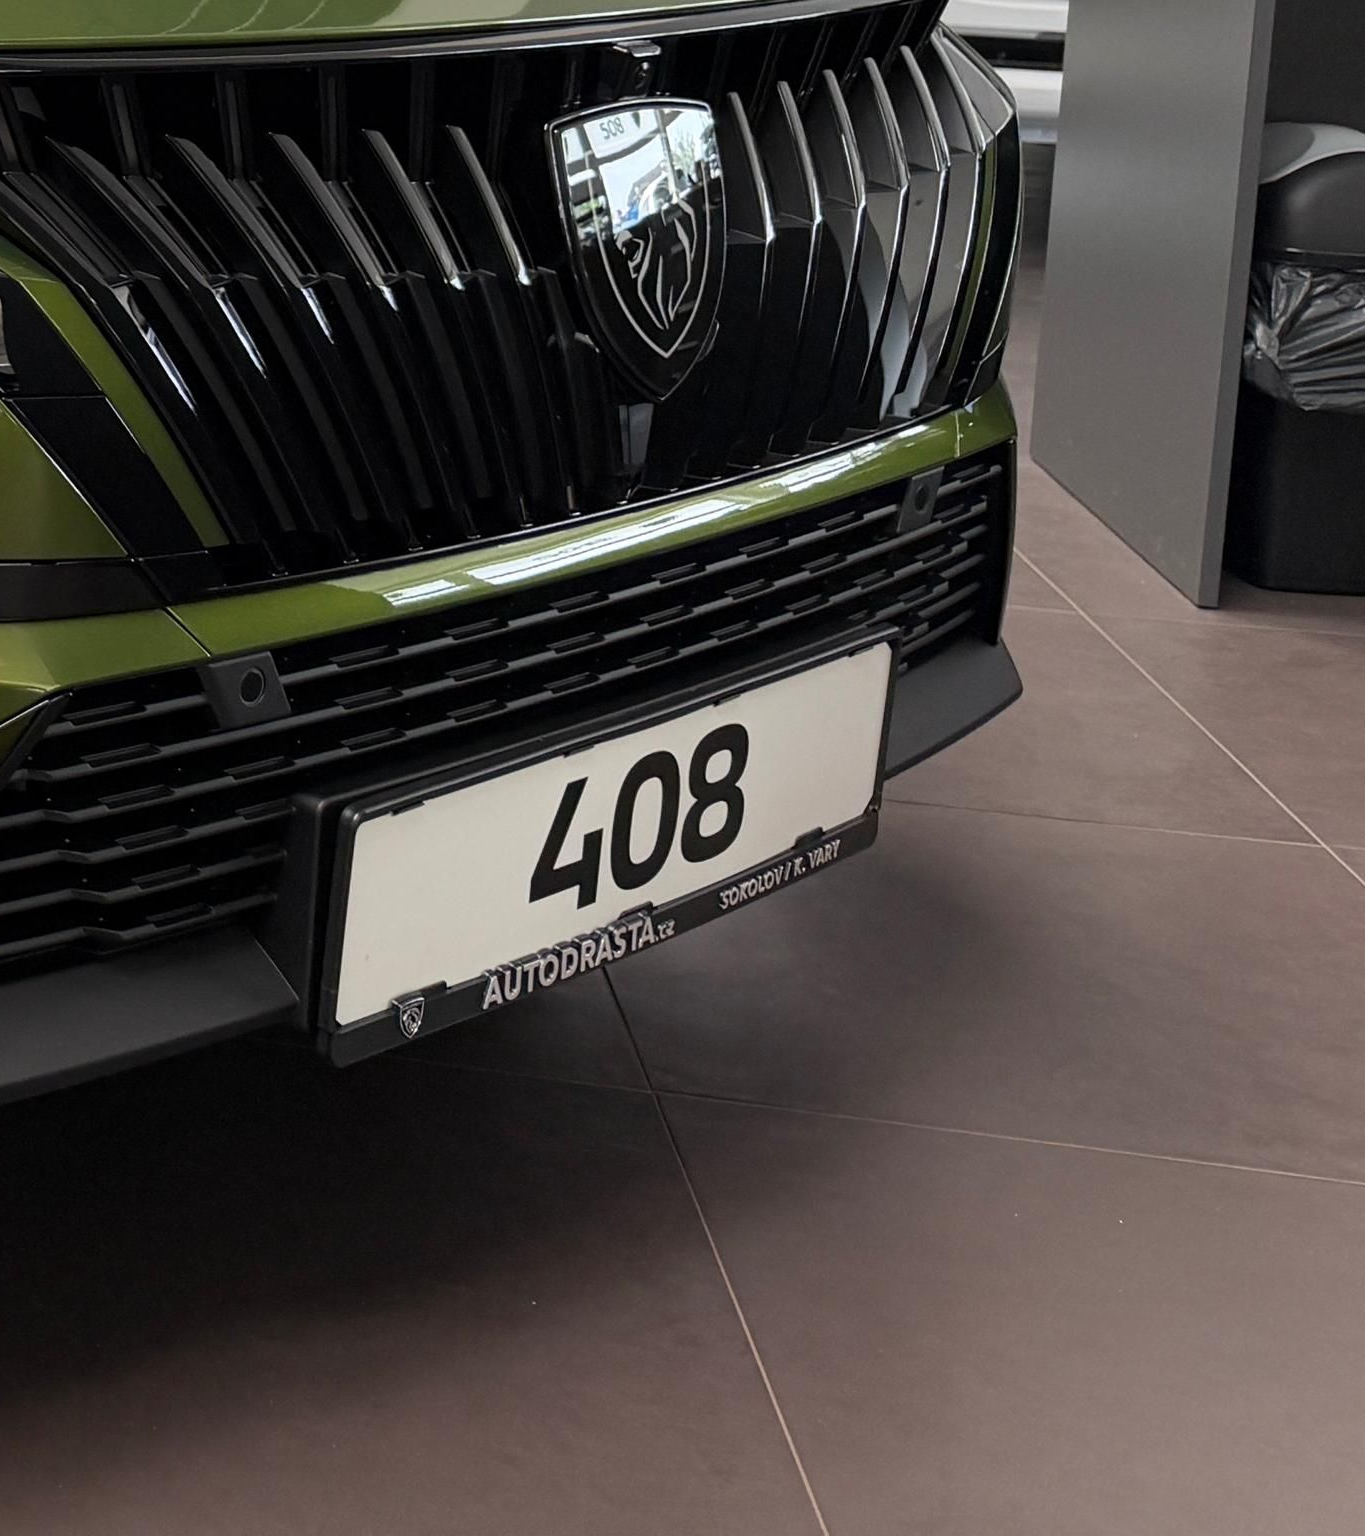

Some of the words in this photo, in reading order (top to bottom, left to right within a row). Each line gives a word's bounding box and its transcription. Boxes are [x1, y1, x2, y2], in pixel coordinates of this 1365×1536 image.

[529, 723, 750, 910] 408
[719, 865, 784, 910] SOKOLOV
[807, 839, 841, 869] VARY
